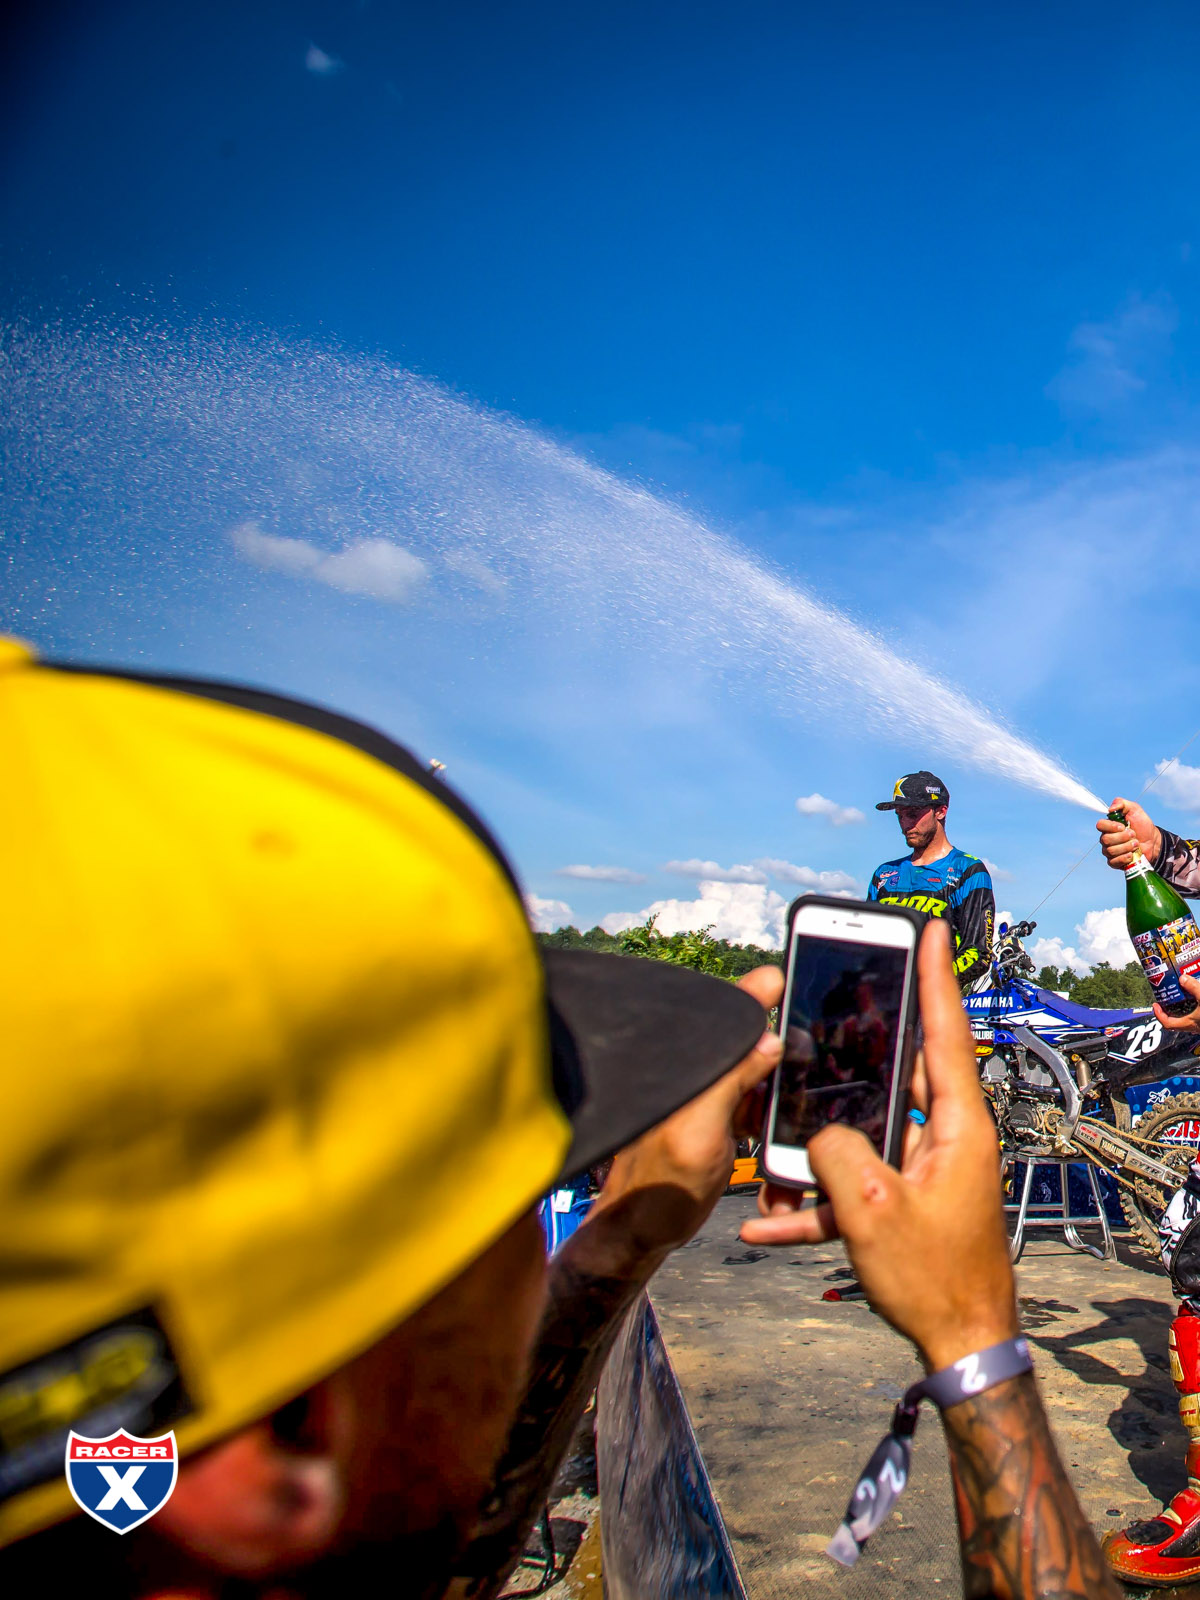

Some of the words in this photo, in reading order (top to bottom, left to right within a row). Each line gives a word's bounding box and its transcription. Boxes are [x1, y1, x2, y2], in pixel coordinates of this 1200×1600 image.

[1183, 963, 1198, 975] JUNE
[969, 996, 1014, 1008] YAMAHA
[1125, 1020, 1163, 1059] 23
